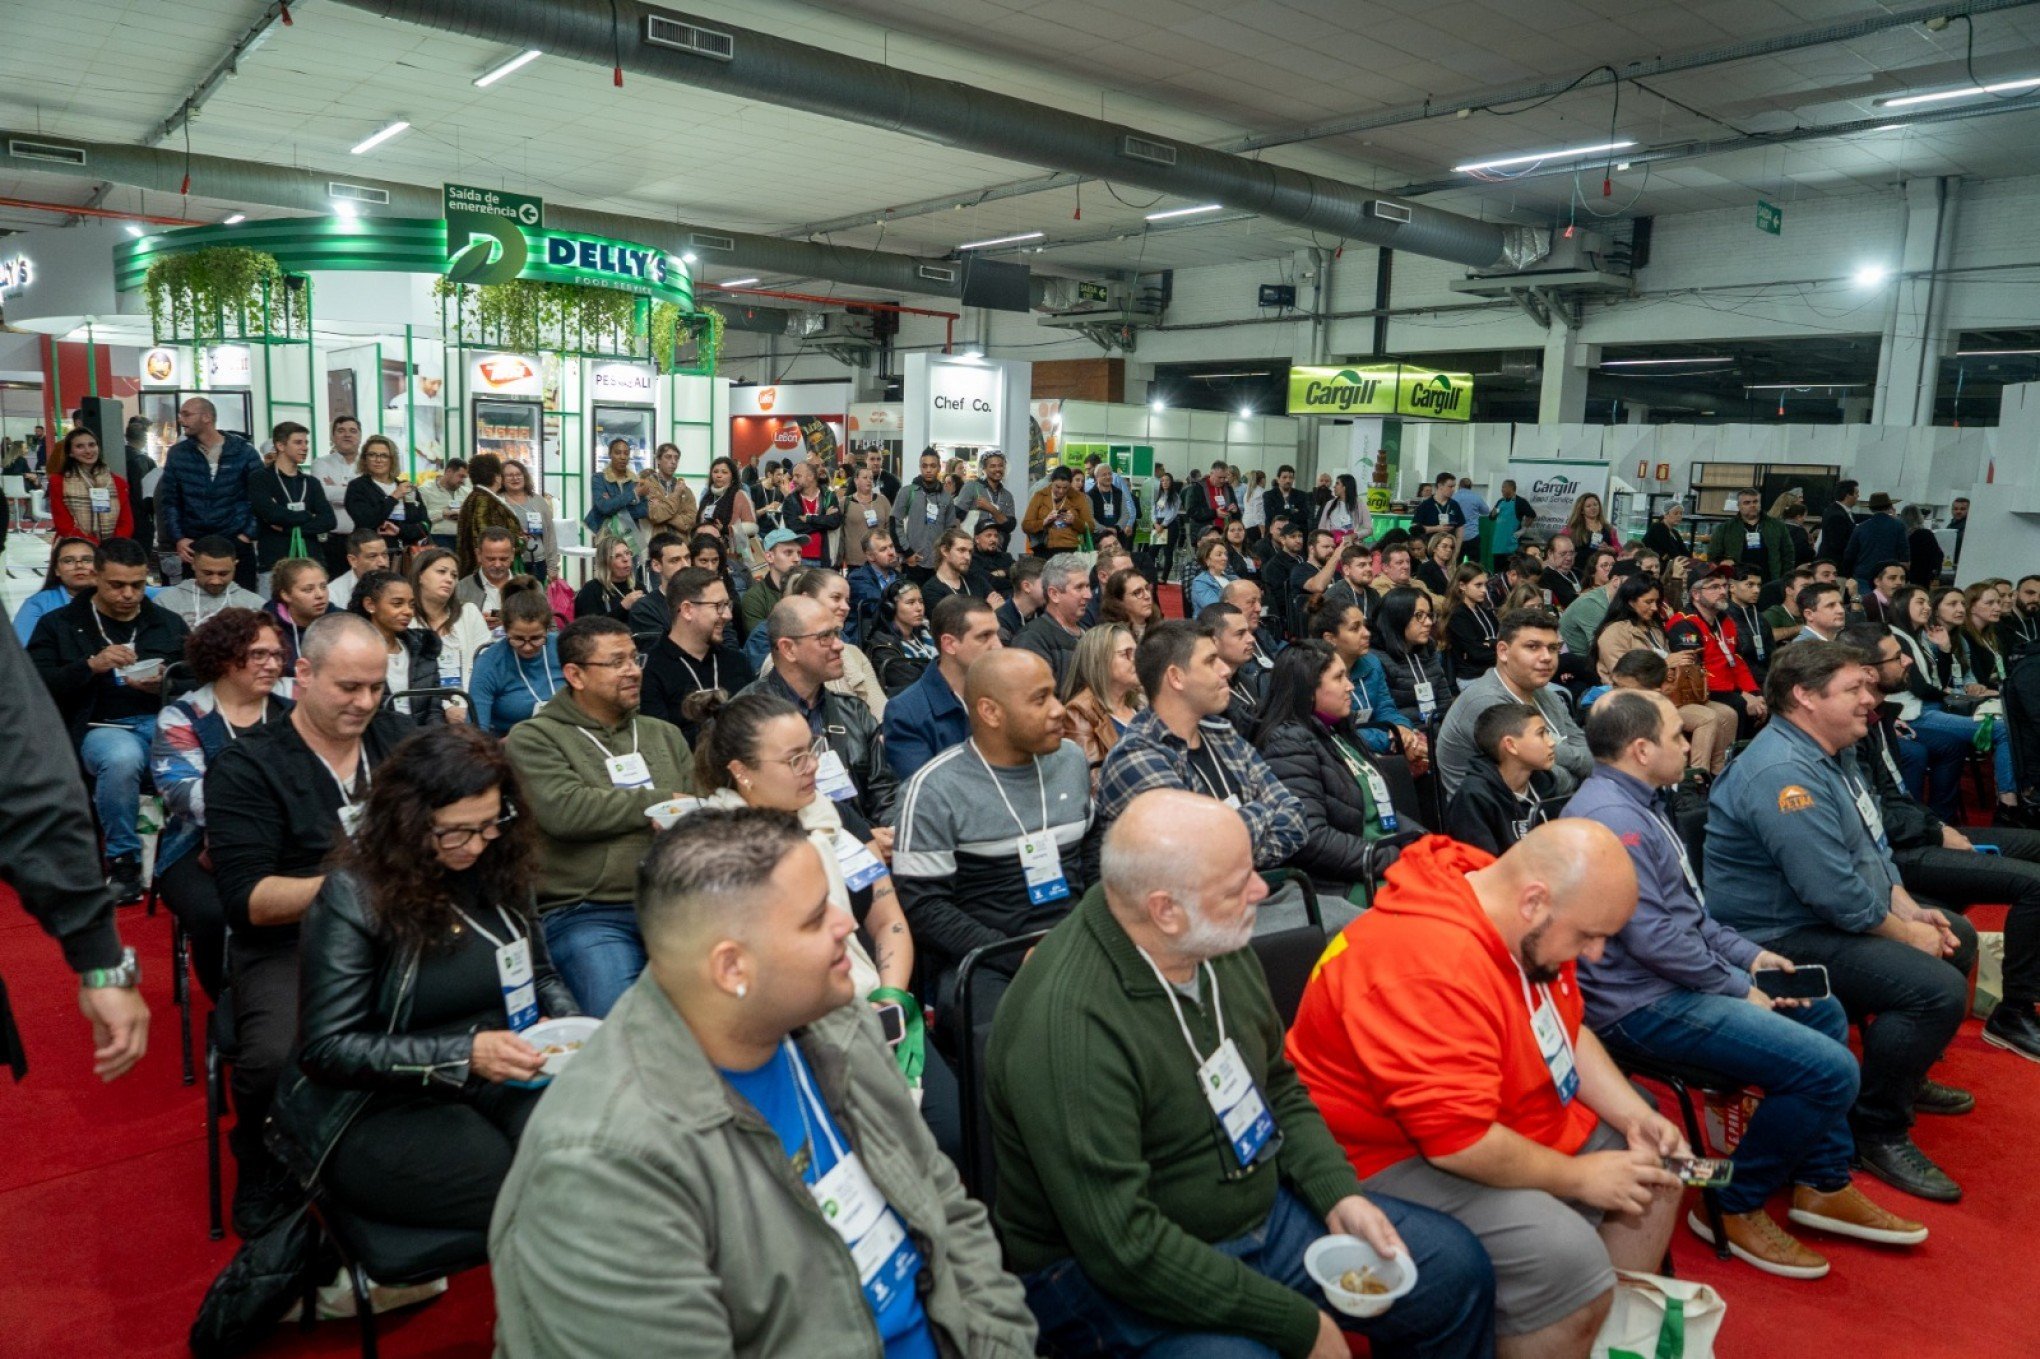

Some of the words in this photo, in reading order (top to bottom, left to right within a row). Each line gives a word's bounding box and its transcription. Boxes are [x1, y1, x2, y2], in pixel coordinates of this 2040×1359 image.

[449, 186, 482, 202] Saída
[484, 190, 500, 204] de
[449, 200, 517, 218] emergência
[548, 236, 667, 284] DELLY'S
[574, 276, 609, 288] FOOD
[613, 281, 653, 294] SERVICE
[934, 395, 965, 410] Chef
[972, 398, 992, 412] Co.
[1305, 379, 1378, 410] Cargill
[1411, 382, 1462, 414] Cargill
[773, 430, 799, 443] LeBon
[1533, 480, 1578, 496] Cargill
